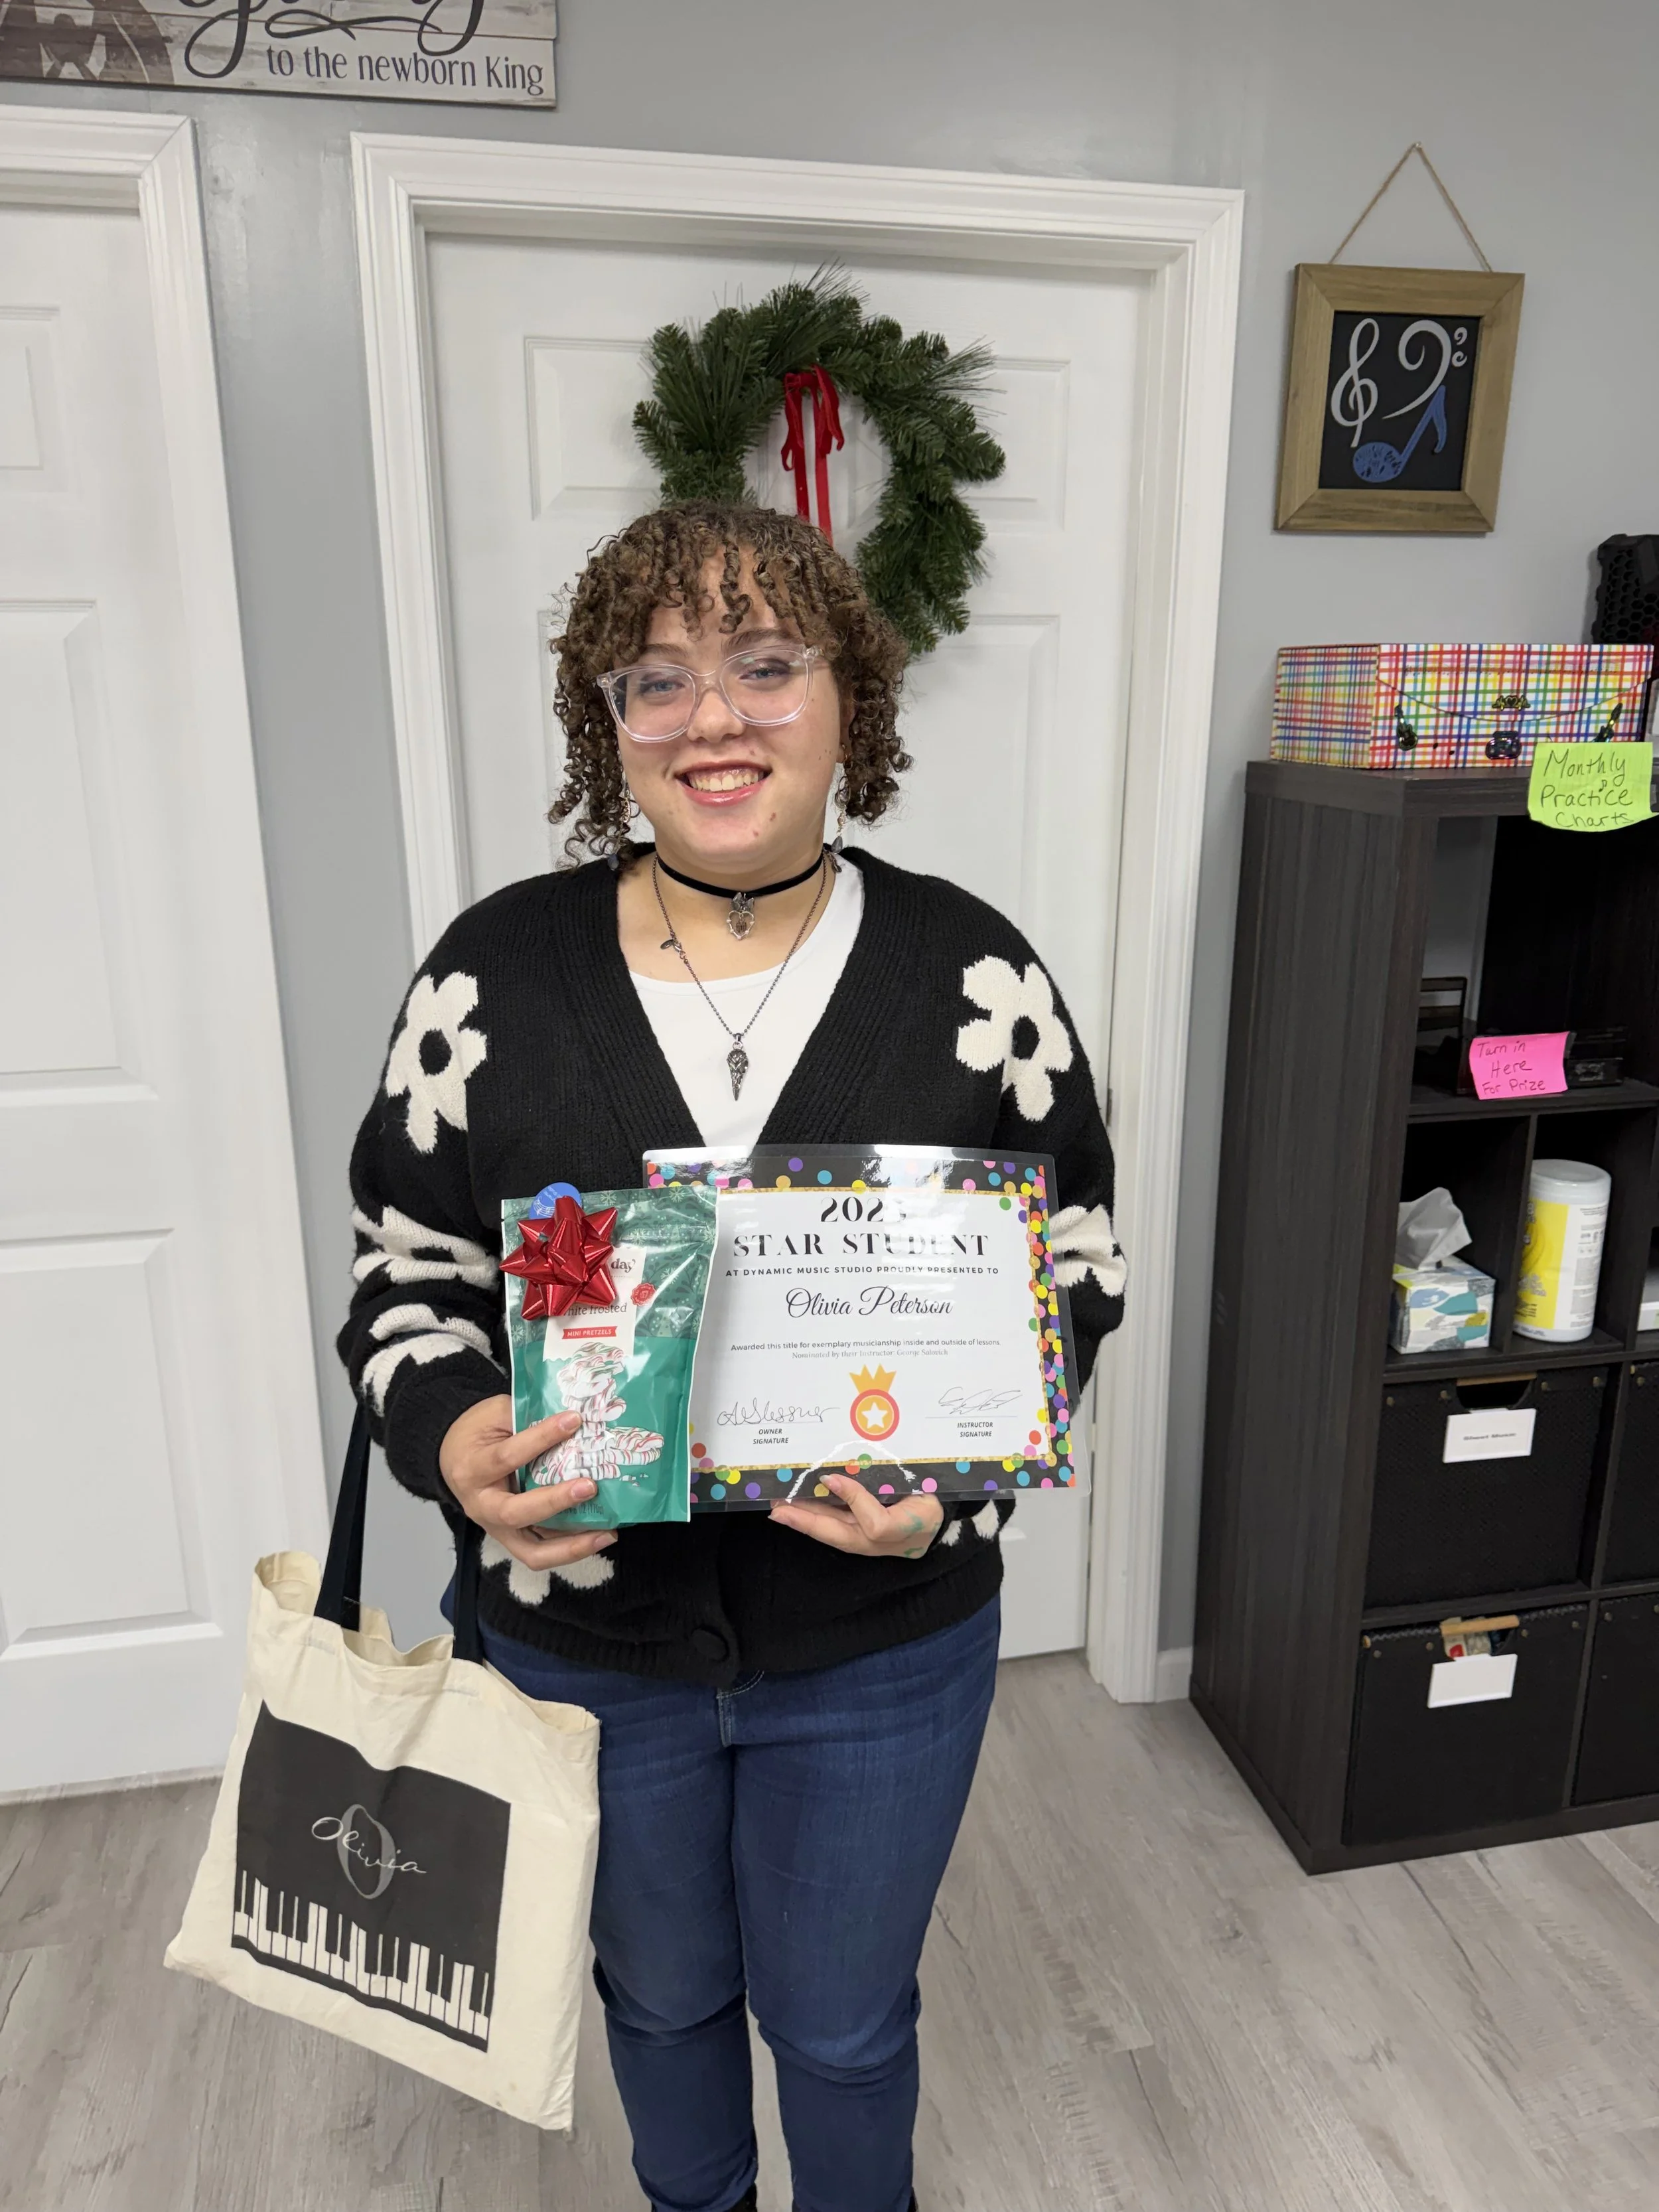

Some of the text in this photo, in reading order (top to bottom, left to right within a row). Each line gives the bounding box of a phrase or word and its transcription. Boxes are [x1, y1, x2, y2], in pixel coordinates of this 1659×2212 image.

[267, 46, 544, 96] to the newborn King
[1544, 747, 1626, 787] Monthly
[1540, 782, 1633, 808] Practice
[1555, 811, 1634, 828] Charts
[1477, 1040, 1526, 1058] Turn in
[1490, 1060, 1532, 1078] Here
[1481, 1078, 1546, 1095] For Prize
[821, 1196, 906, 1222] 202
[734, 1233, 825, 1257] STAR
[611, 1258, 636, 1274] day
[743, 1267, 793, 1276] DYNAMIC
[786, 1285, 954, 1318] Olivia Peterson
[565, 1305, 587, 1317] hite
[583, 1328, 612, 1337] PRETZELS
[731, 1343, 765, 1351] Awarded
[812, 1341, 851, 1351] exemplary
[853, 1339, 902, 1349] musicianship
[792, 1351, 830, 1359] Nominated
[831, 1350, 840, 1359] by
[841, 1349, 857, 1358] their
[897, 1349, 920, 1357] George
[311, 1816, 427, 1874] Olivia
